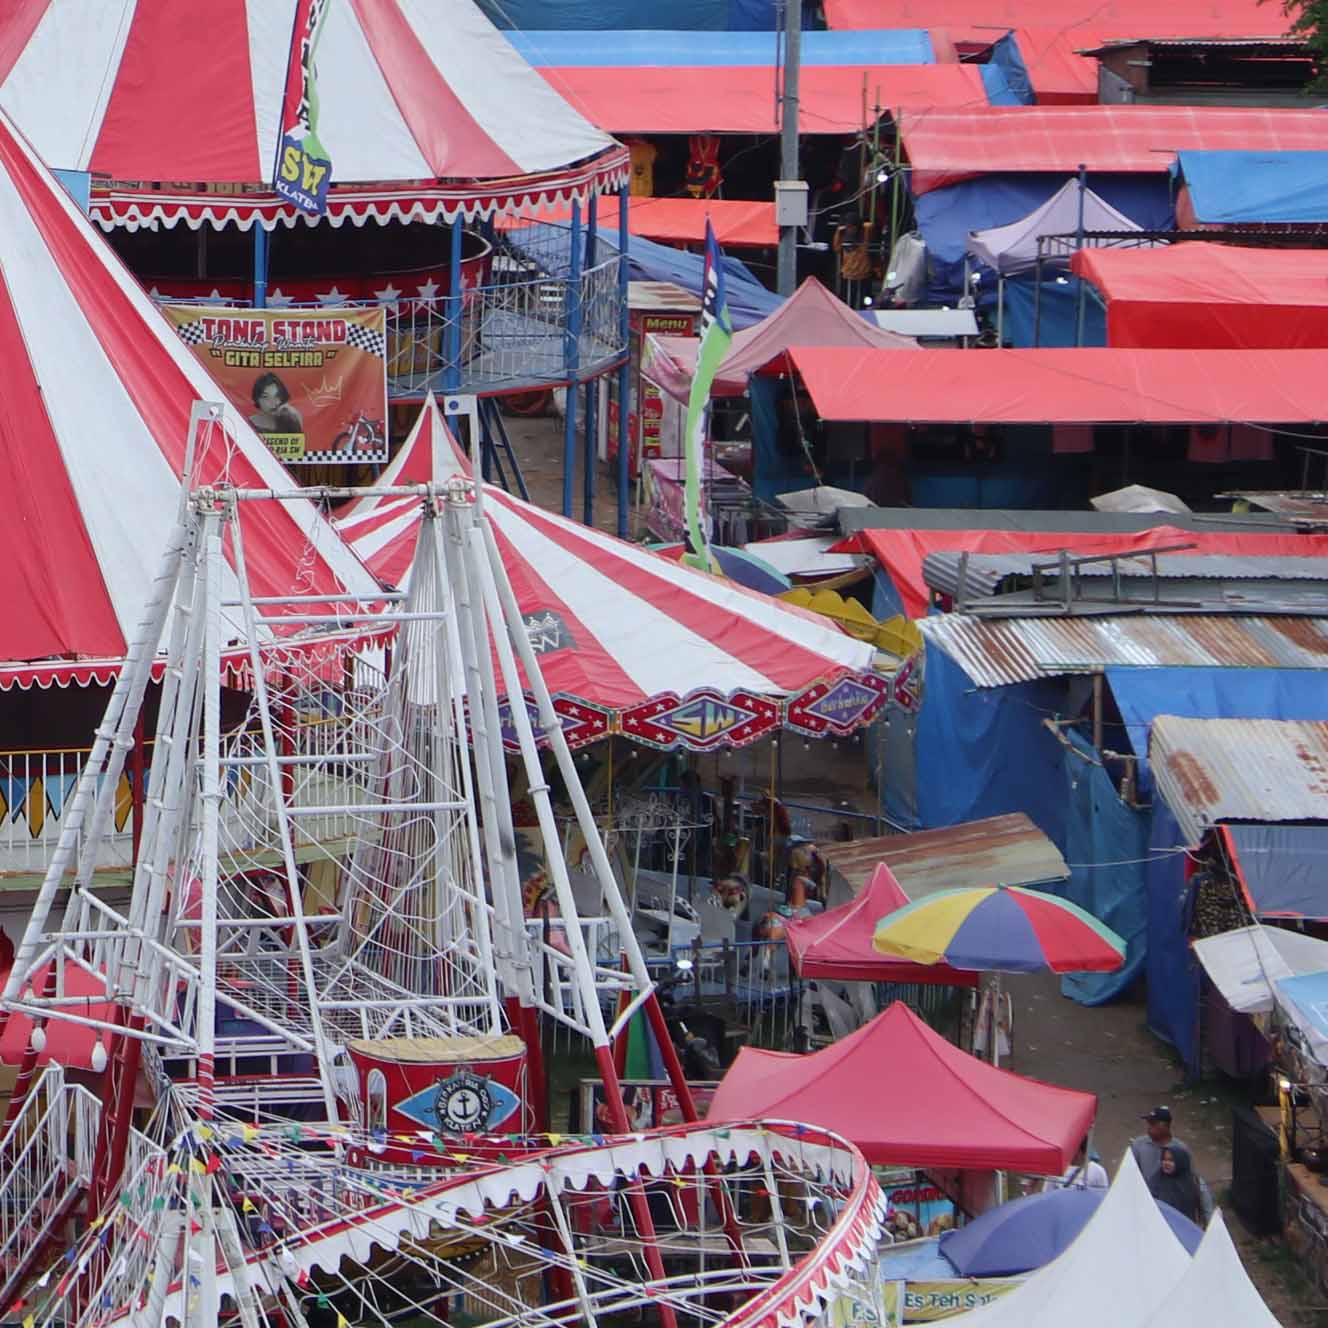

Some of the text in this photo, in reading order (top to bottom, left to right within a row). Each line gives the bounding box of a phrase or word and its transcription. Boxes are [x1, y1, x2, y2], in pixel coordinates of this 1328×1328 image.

[201, 318, 348, 343] TONG STAND
[646, 316, 688, 330] Menu
[224, 350, 261, 368] GITA
[672, 703, 738, 733] SW
[904, 1292, 924, 1309] Es
[930, 1292, 960, 1307] Teh
